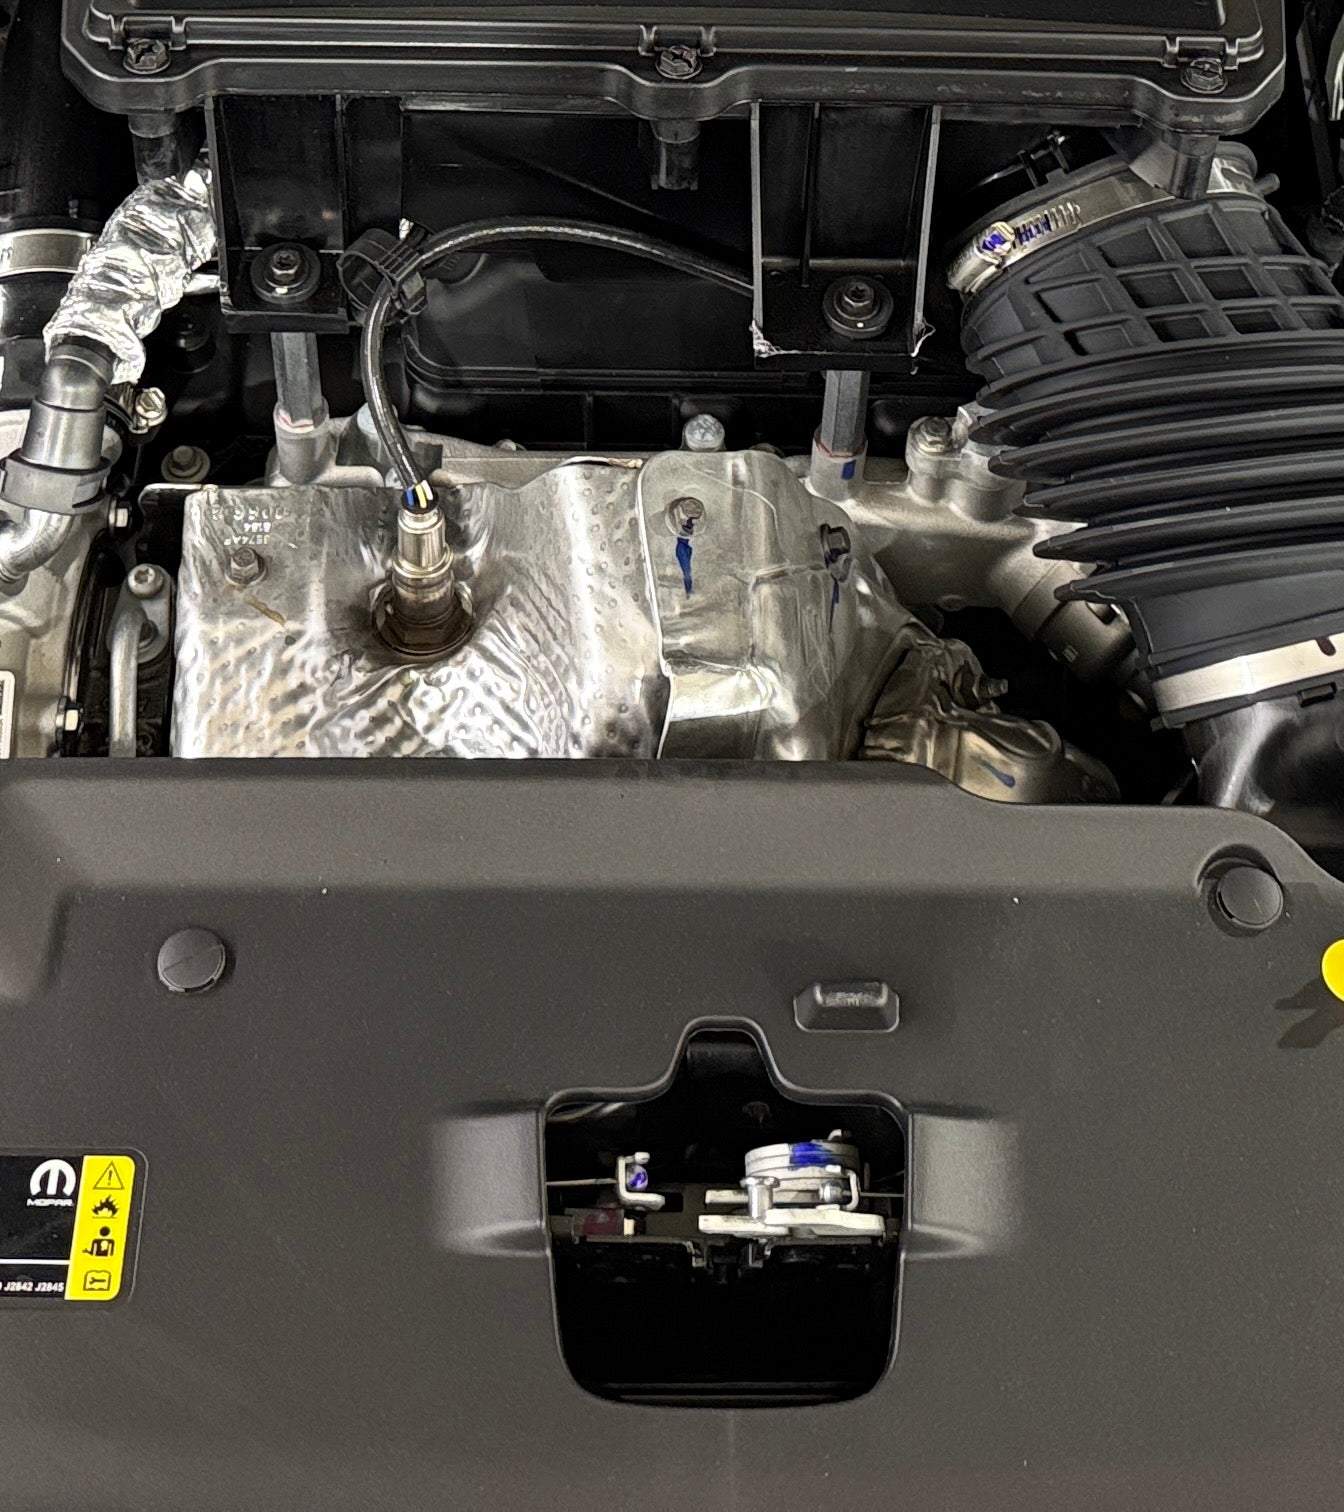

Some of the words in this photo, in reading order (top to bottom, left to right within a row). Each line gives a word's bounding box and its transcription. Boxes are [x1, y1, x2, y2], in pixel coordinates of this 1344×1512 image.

[26, 1198, 73, 1207] MOPAR
[4, 1281, 33, 1292] J2842
[35, 1282, 64, 1292] J2845
